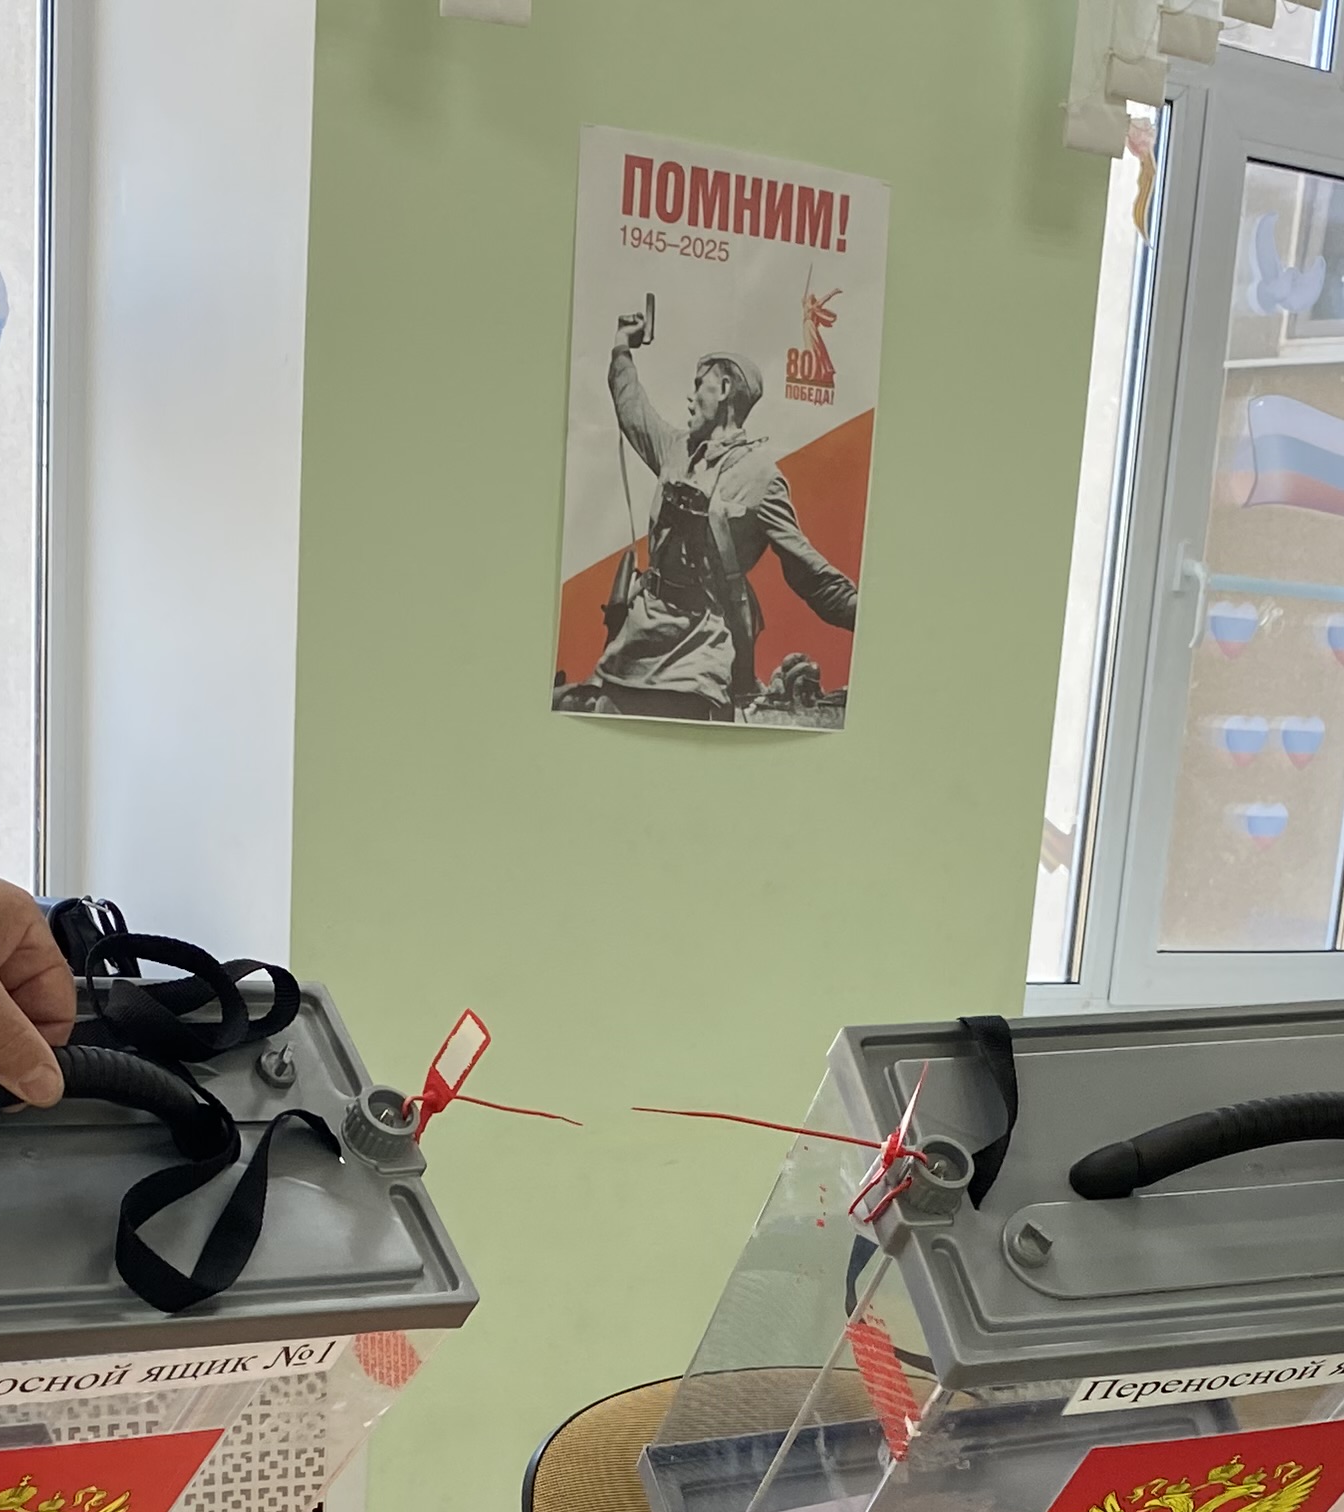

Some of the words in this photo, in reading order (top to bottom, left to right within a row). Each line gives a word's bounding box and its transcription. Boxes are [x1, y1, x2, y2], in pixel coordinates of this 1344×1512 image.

[622, 153, 850, 253] ПОМНИМ!
[786, 347, 814, 380] 80
[785, 383, 835, 406] ПОБЕДА!
[137, 1354, 258, 1381] ящик
[263, 1340, 336, 1370] №1
[1080, 1358, 1327, 1403] Переносной
